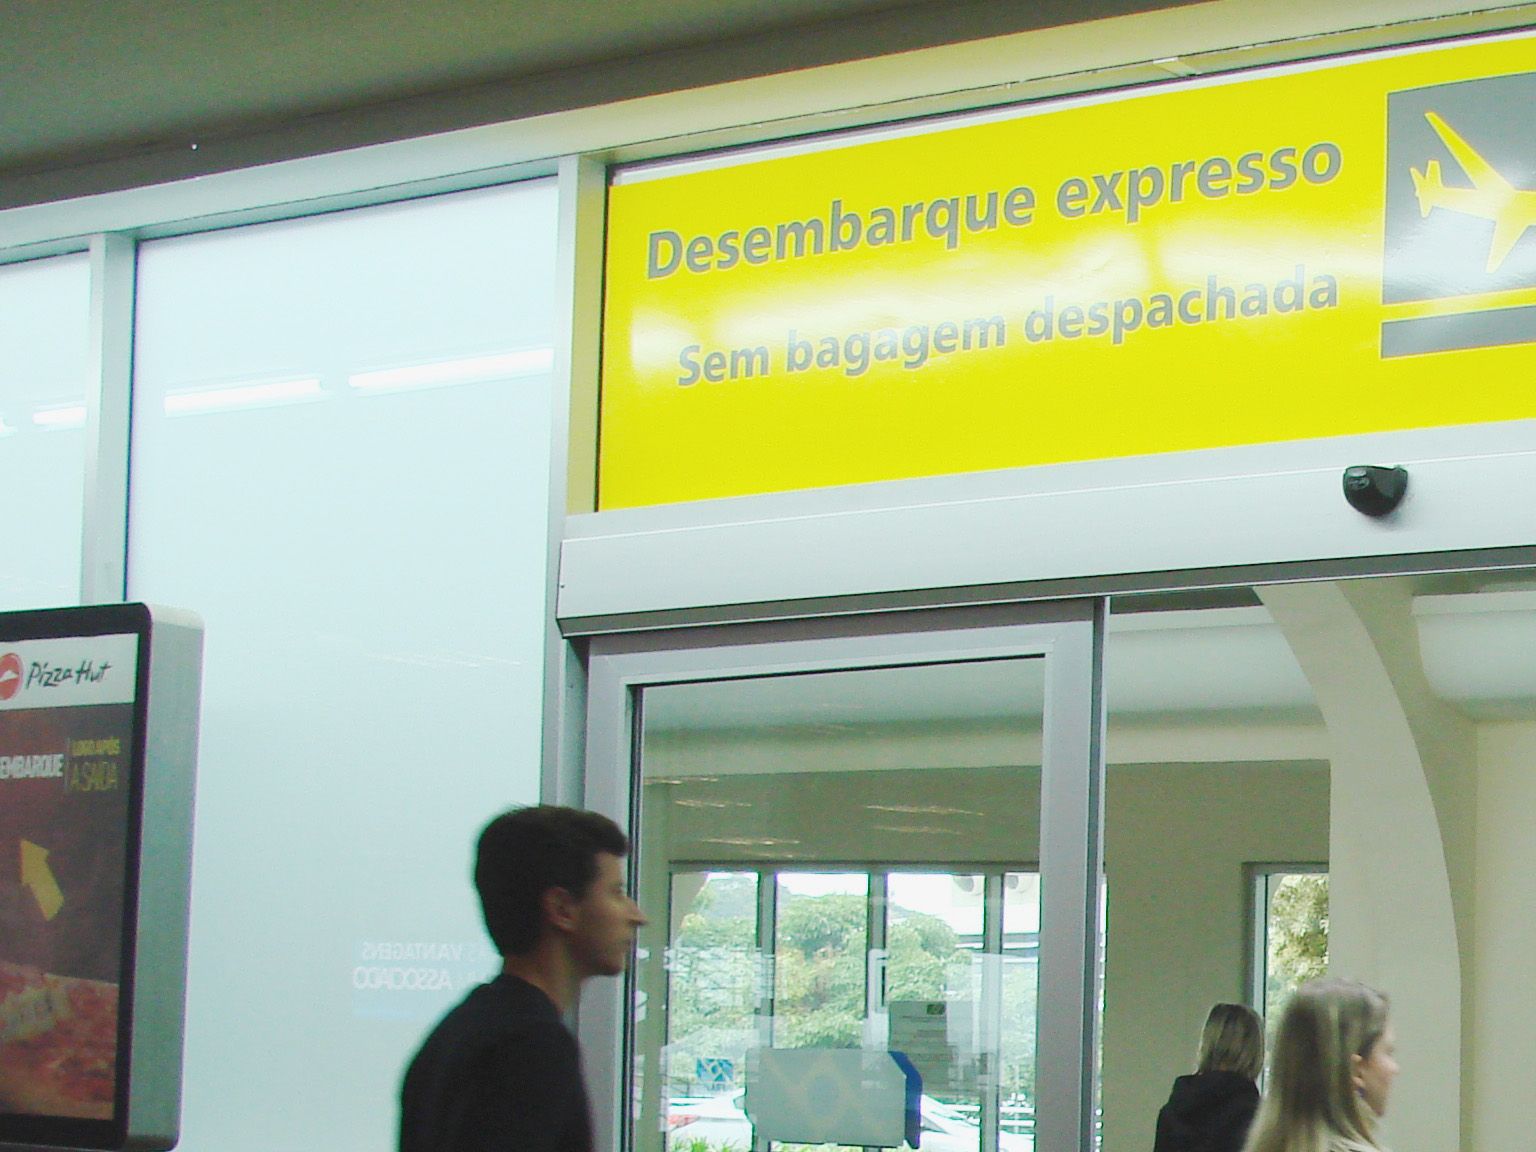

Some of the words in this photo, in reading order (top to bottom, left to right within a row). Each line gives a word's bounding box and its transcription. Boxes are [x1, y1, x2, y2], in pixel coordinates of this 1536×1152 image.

[647, 185, 1036, 280] Desembarque
[1056, 142, 1342, 224] expresso
[677, 344, 769, 386] Sem
[786, 314, 1005, 377] bagagem
[1024, 264, 1338, 344] despachada
[27, 661, 73, 689] Pizza
[75, 658, 112, 685] Hut
